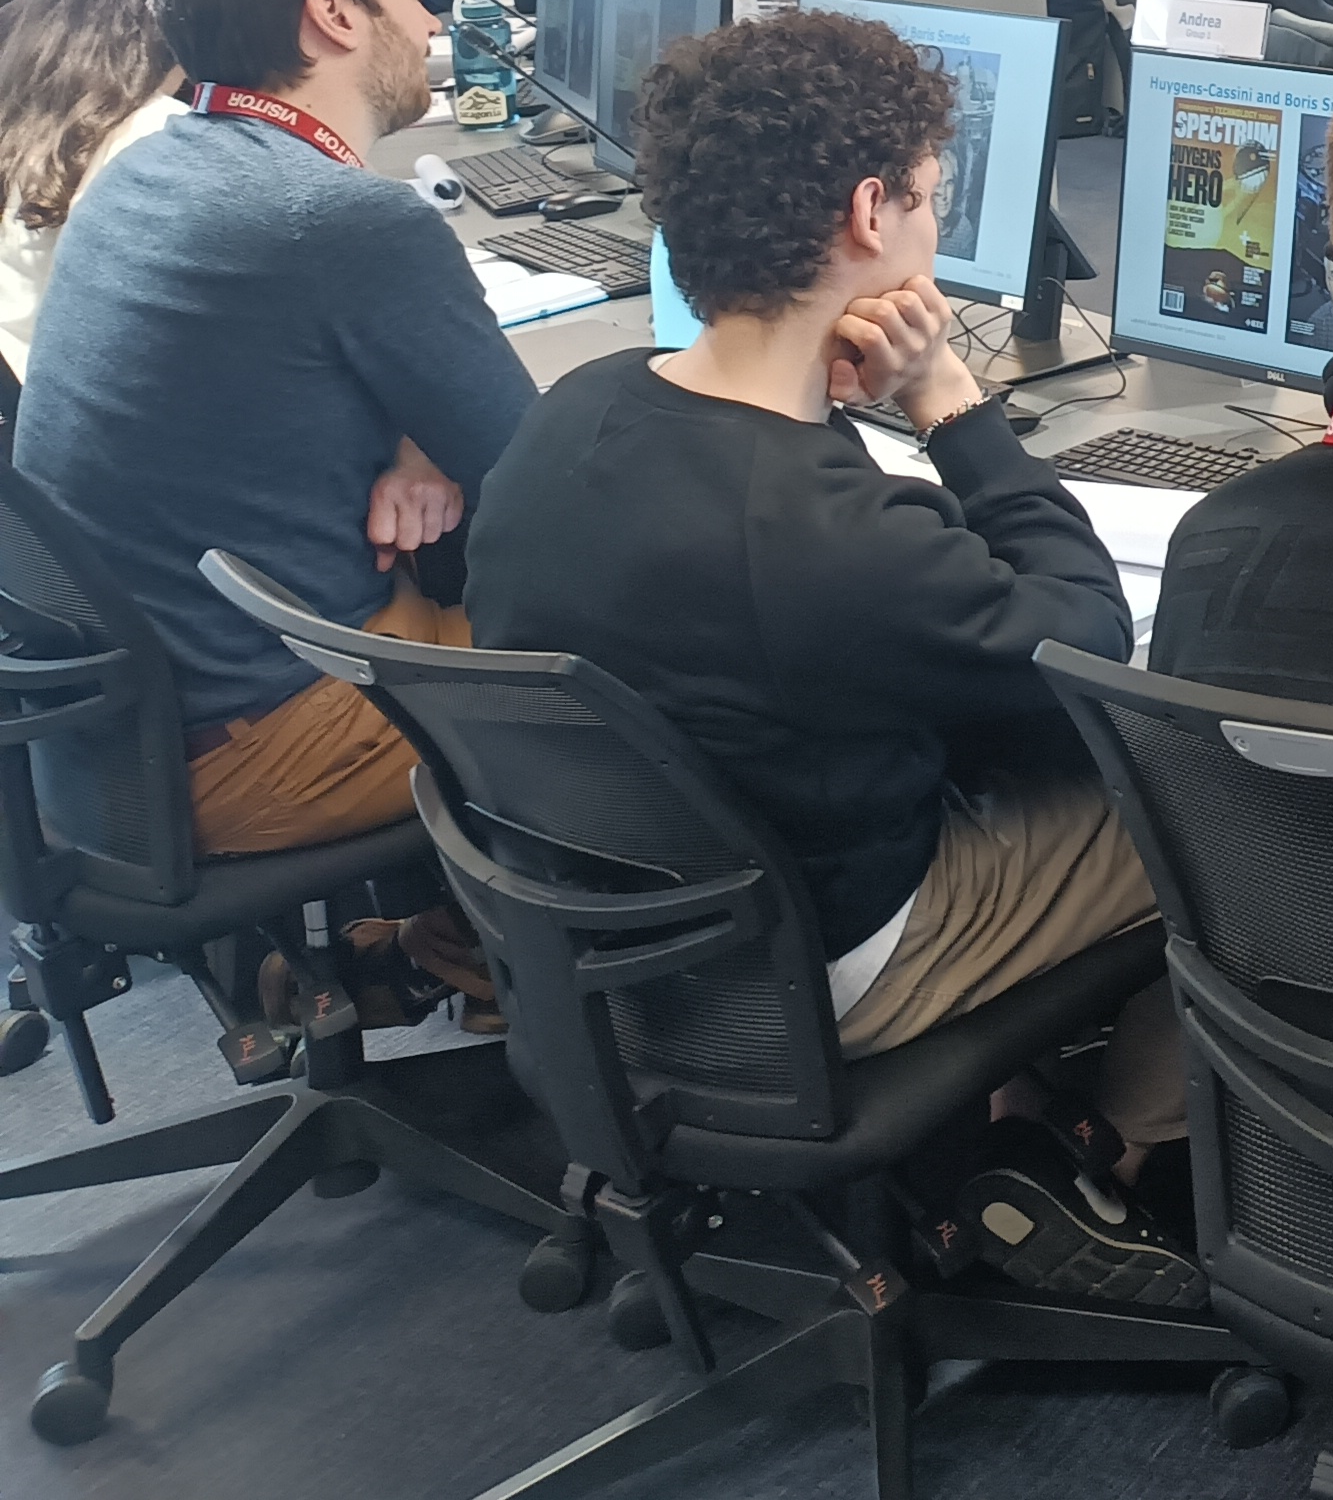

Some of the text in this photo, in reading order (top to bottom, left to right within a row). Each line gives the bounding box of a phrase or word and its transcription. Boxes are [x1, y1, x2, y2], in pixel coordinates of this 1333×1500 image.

[1178, 11, 1222, 29] Andrea
[910, 28, 935, 42] Boris
[937, 29, 971, 45] Smeds
[1150, 76, 1253, 101] Huygens-Cassini
[1256, 90, 1280, 106] and
[1284, 93, 1318, 110] Boris
[227, 92, 298, 126] VISITOR
[1174, 110, 1279, 151] SPECTRUM
[1170, 144, 1222, 170] HUYGENS
[1168, 164, 1224, 208] HERO
[1266, 371, 1285, 382] DELL
